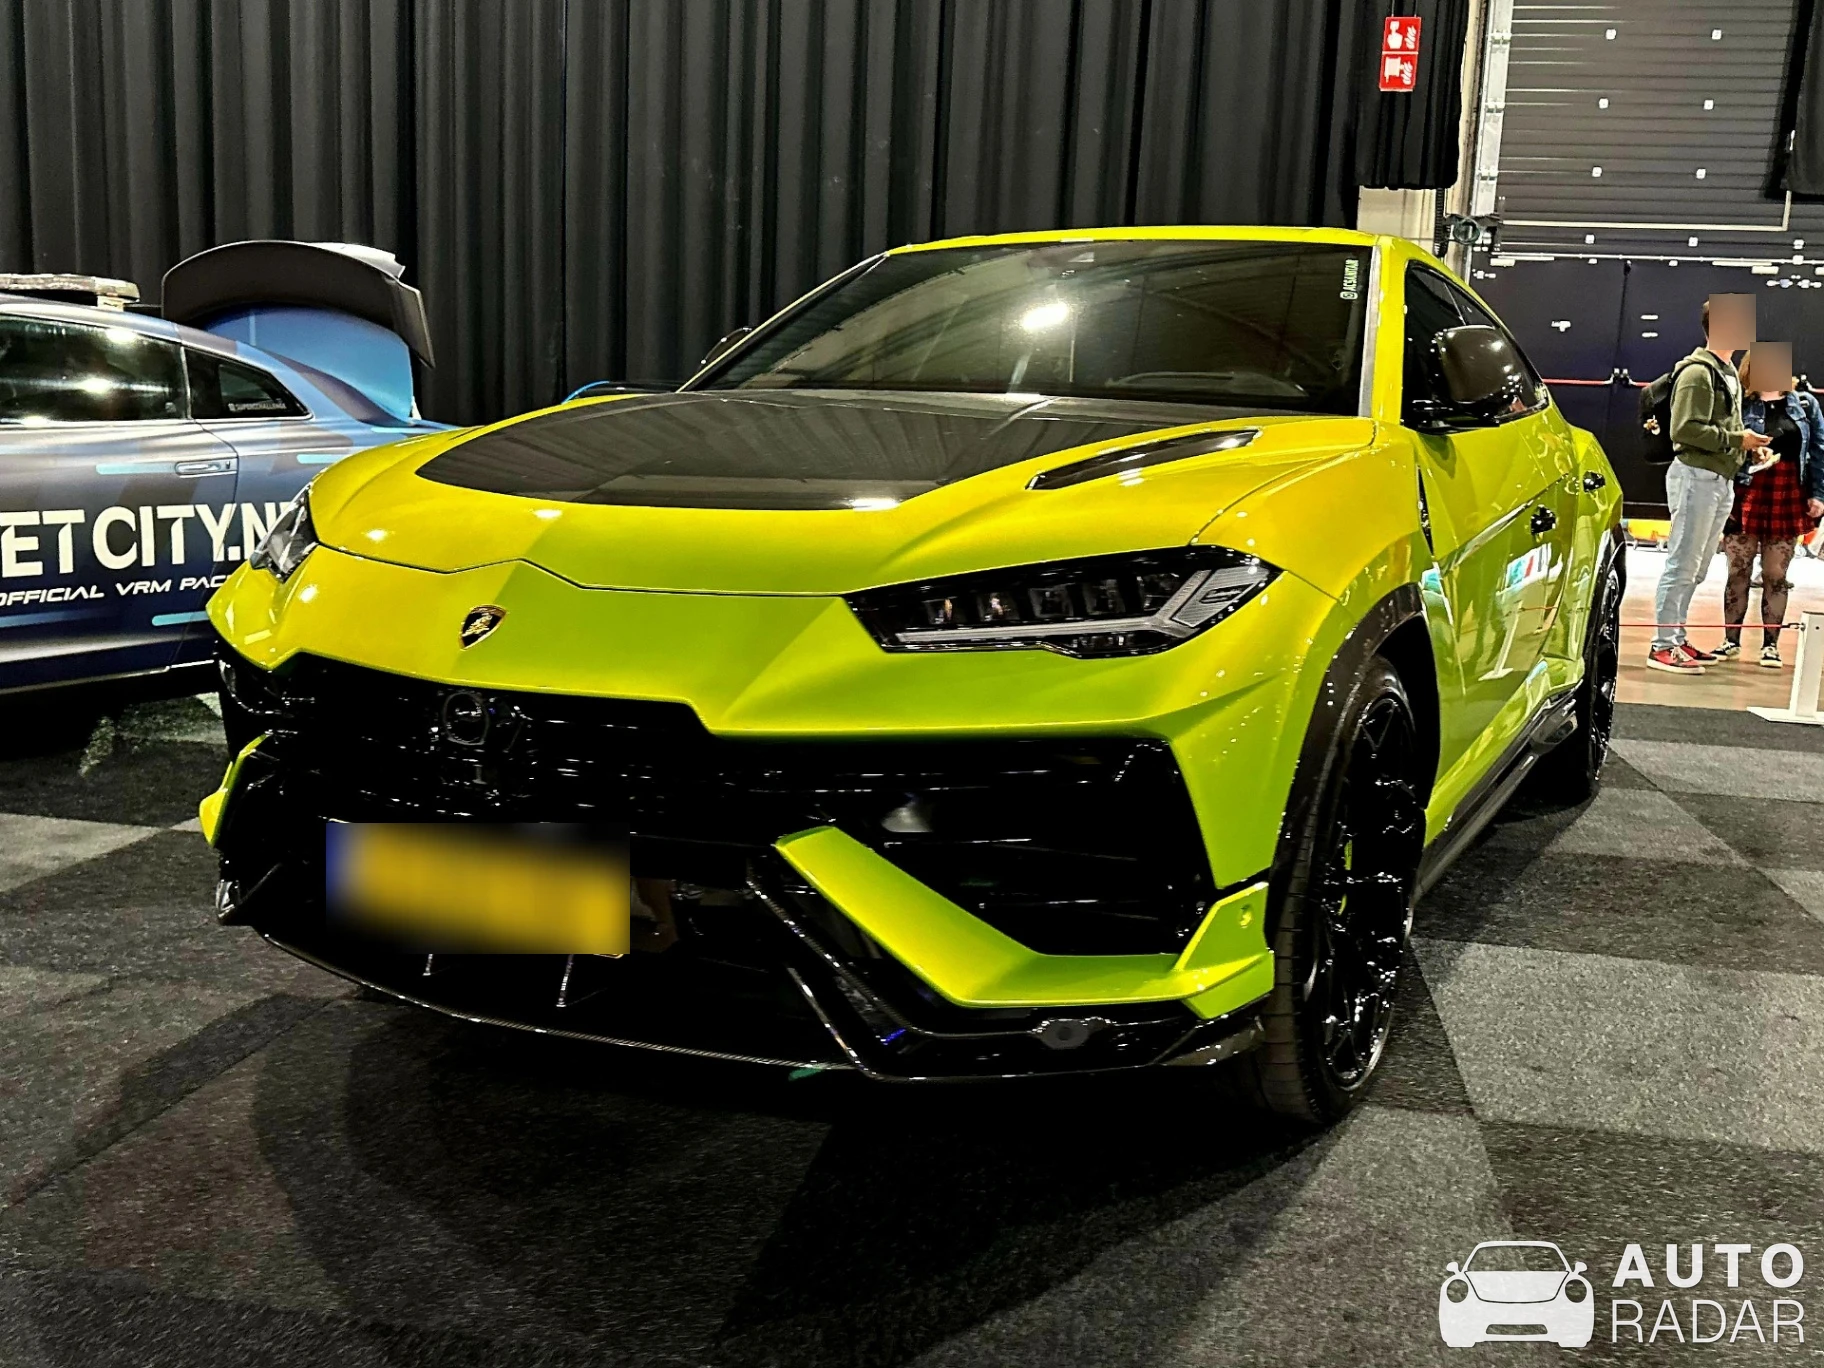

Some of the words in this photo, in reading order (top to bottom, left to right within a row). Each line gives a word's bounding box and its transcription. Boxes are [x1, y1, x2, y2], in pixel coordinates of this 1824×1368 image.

[93, 502, 293, 570] CITY.N
[115, 579, 172, 596] VRM
[179, 574, 232, 591] PAC
